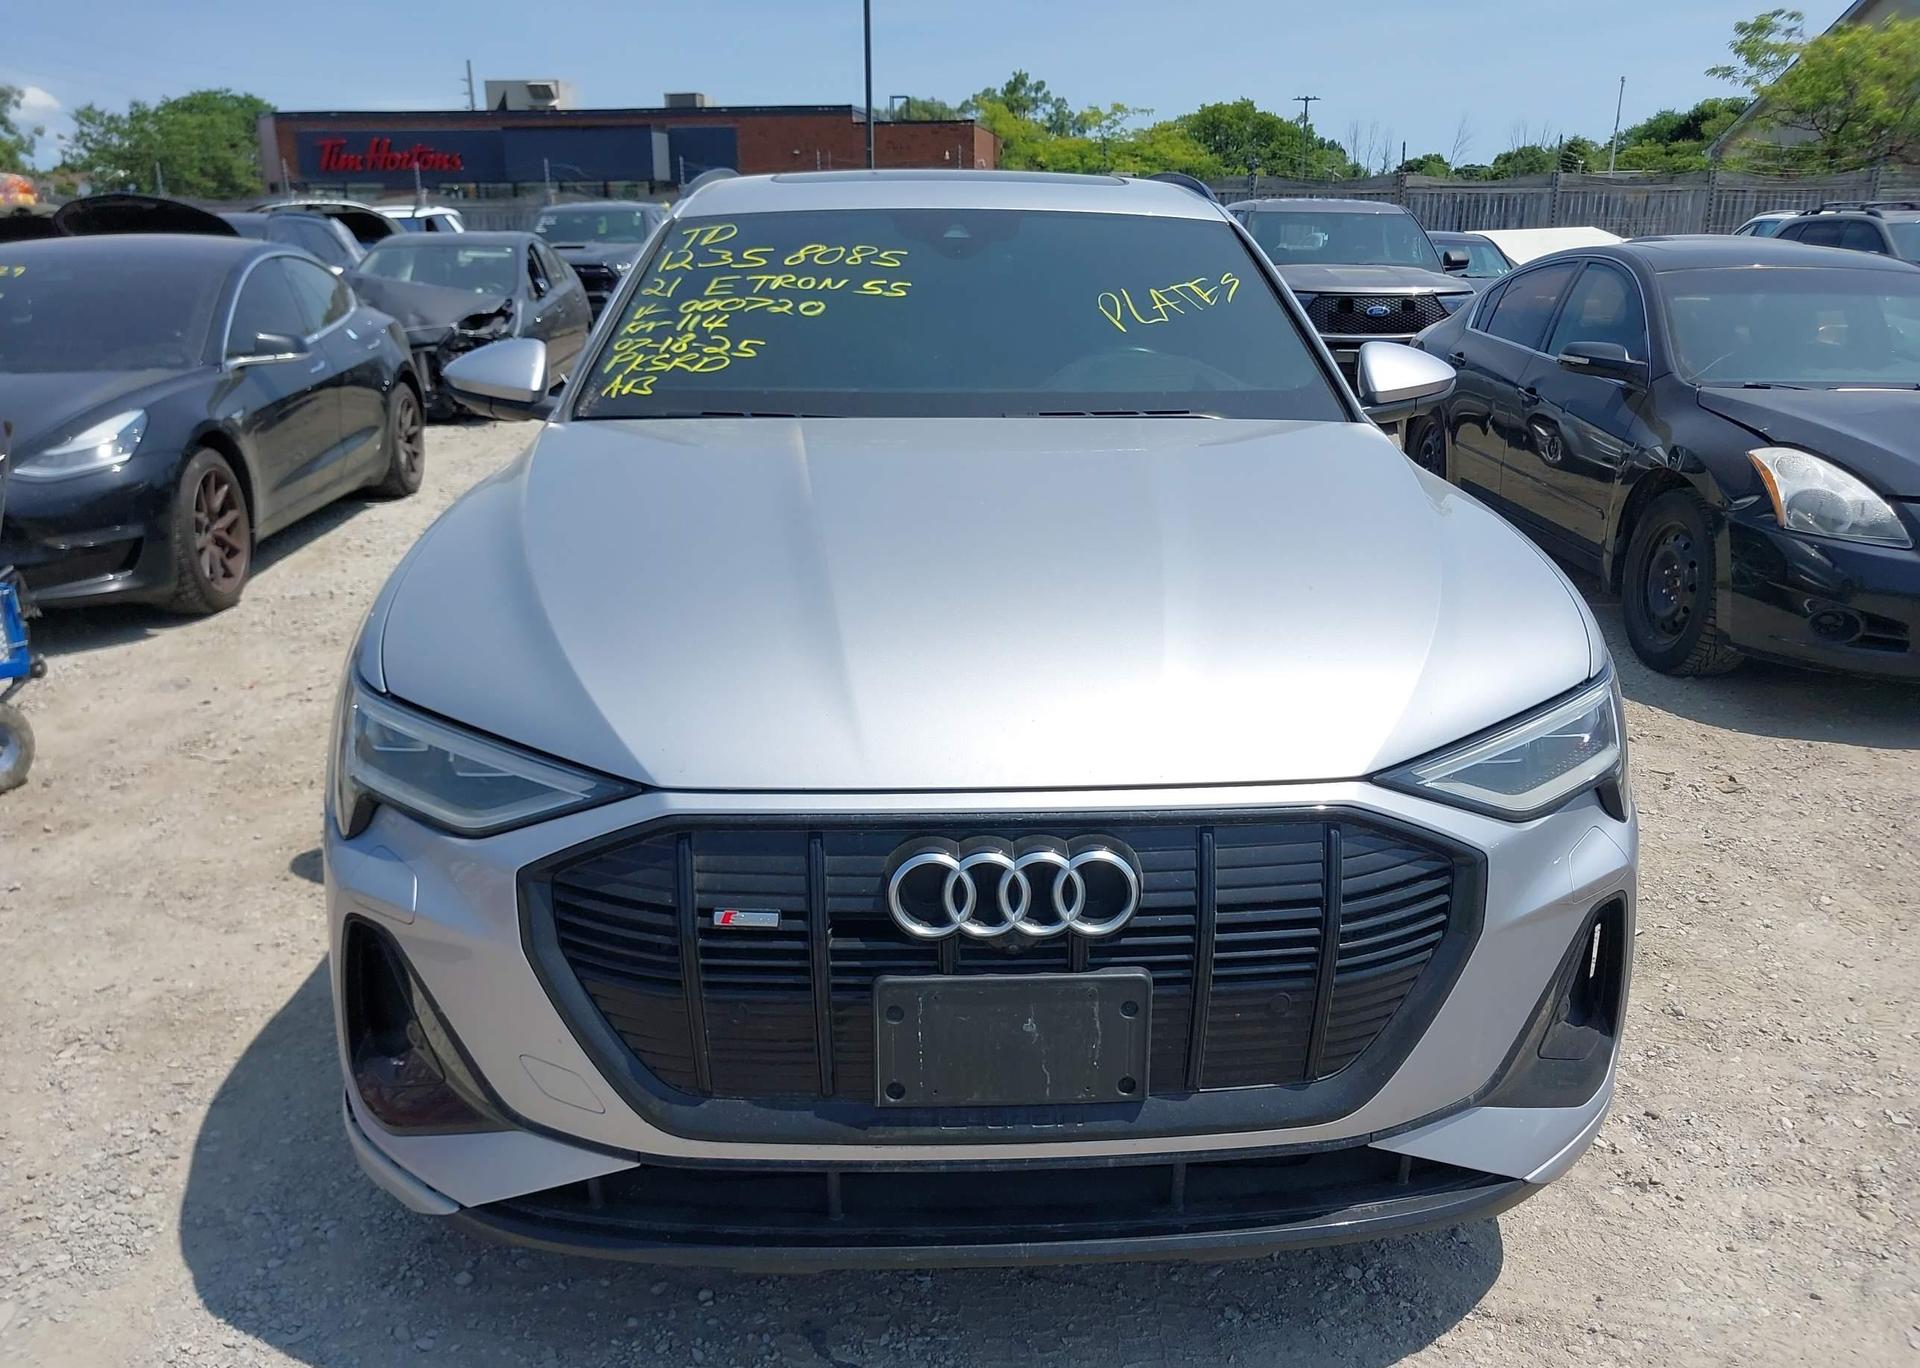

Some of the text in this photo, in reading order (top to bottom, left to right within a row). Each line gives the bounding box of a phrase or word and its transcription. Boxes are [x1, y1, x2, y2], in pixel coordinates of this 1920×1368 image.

[316, 135, 464, 172] Tim Hortons
[641, 275, 683, 298] 21
[1096, 271, 1241, 334] PLATES
